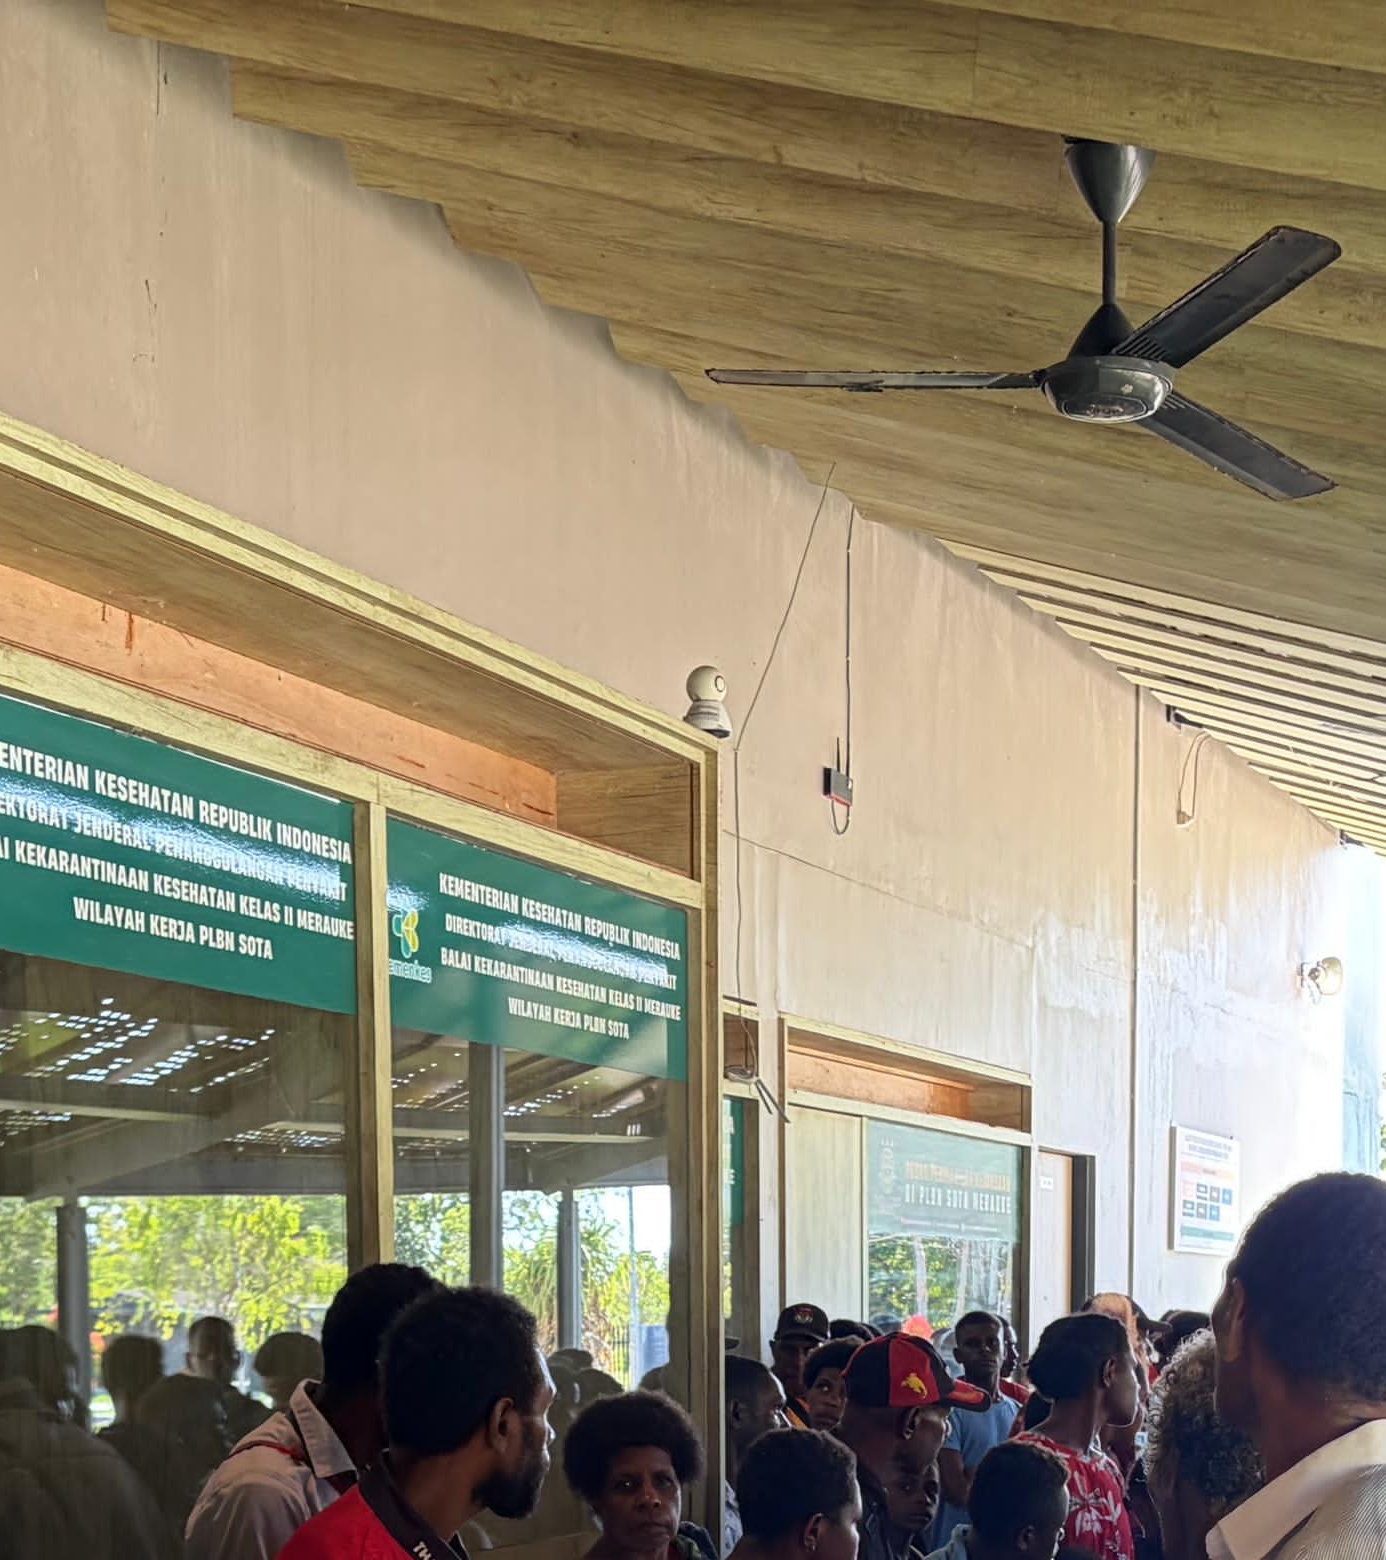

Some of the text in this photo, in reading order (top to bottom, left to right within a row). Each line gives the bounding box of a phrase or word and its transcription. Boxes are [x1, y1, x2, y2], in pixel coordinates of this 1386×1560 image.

[73, 811, 151, 852] JENDERAL
[94, 769, 194, 820] KESEHATAN
[198, 799, 273, 842] REPUBLIK
[276, 822, 353, 865] INDONESIA
[15, 839, 150, 893] KEKARANTINAAN
[153, 872, 237, 913] KESEHATAN
[239, 895, 281, 924] KELAS
[284, 905, 294, 926] II
[297, 908, 355, 941] MERAUKE
[439, 872, 519, 915] KEMENTERIAN
[521, 897, 582, 932] KESEHATAN
[584, 916, 630, 947] REPUBLIK
[632, 929, 681, 961] INDONESIA
[73, 896, 274, 961] WILAYAH KERJA PLBN SOTA
[445, 913, 505, 946] DIREKTORAT
[440, 946, 472, 972] BALAI
[474, 955, 555, 991] KEKARANTINAAN
[556, 975, 607, 1004] KESEHATAN
[609, 988, 635, 1011] KELAS
[644, 998, 682, 1021] MERAUKE
[508, 997, 630, 1040] WILAYAH KERJA PLBN SOTA
